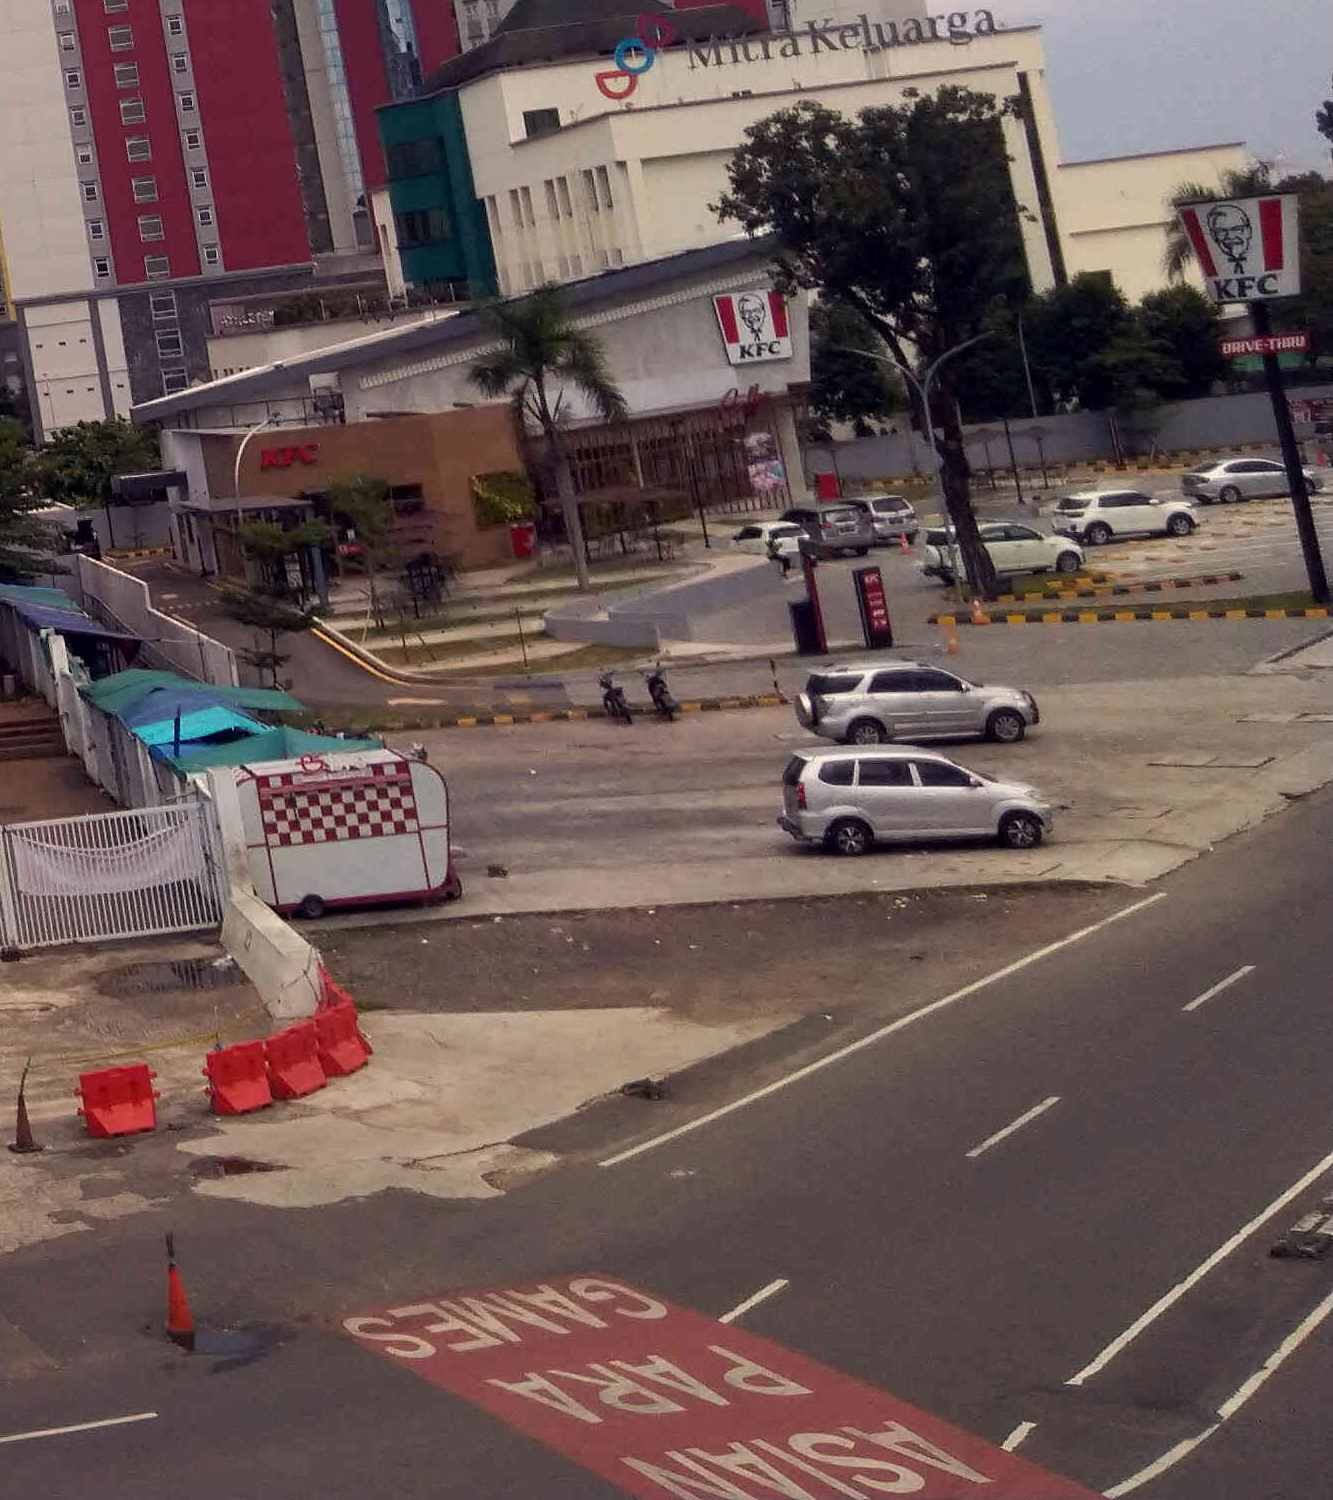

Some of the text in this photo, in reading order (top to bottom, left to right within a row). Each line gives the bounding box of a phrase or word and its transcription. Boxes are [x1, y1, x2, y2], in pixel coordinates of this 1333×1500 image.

[687, 8, 997, 70] Mitra Keluarga
[1214, 274, 1279, 299] KFC
[740, 340, 782, 361] KFC
[1222, 337, 1305, 355] DRIVE-THRU
[261, 444, 317, 468] KFC
[342, 1277, 667, 1359] GAMES
[485, 1344, 813, 1424] PARA
[621, 1420, 995, 1500] ASIAN
